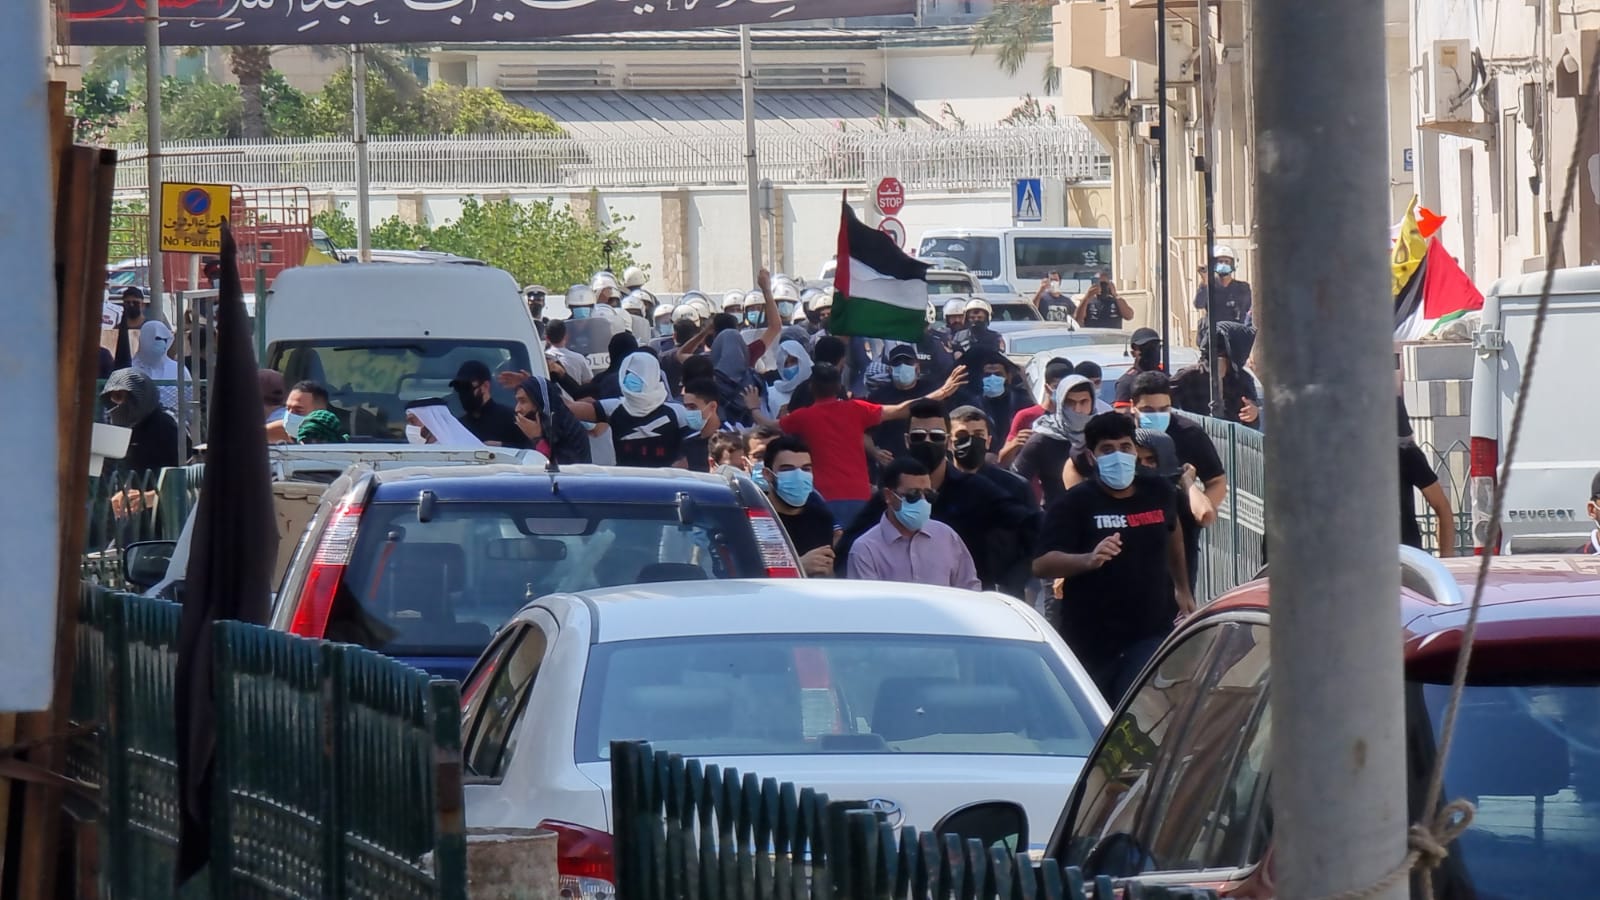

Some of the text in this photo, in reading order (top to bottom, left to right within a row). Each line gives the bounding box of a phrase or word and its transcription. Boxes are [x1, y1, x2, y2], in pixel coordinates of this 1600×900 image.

[879, 196, 902, 208] STOP
[163, 235, 220, 248] No Parkin
[1508, 508, 1576, 520] PEUGEOT
